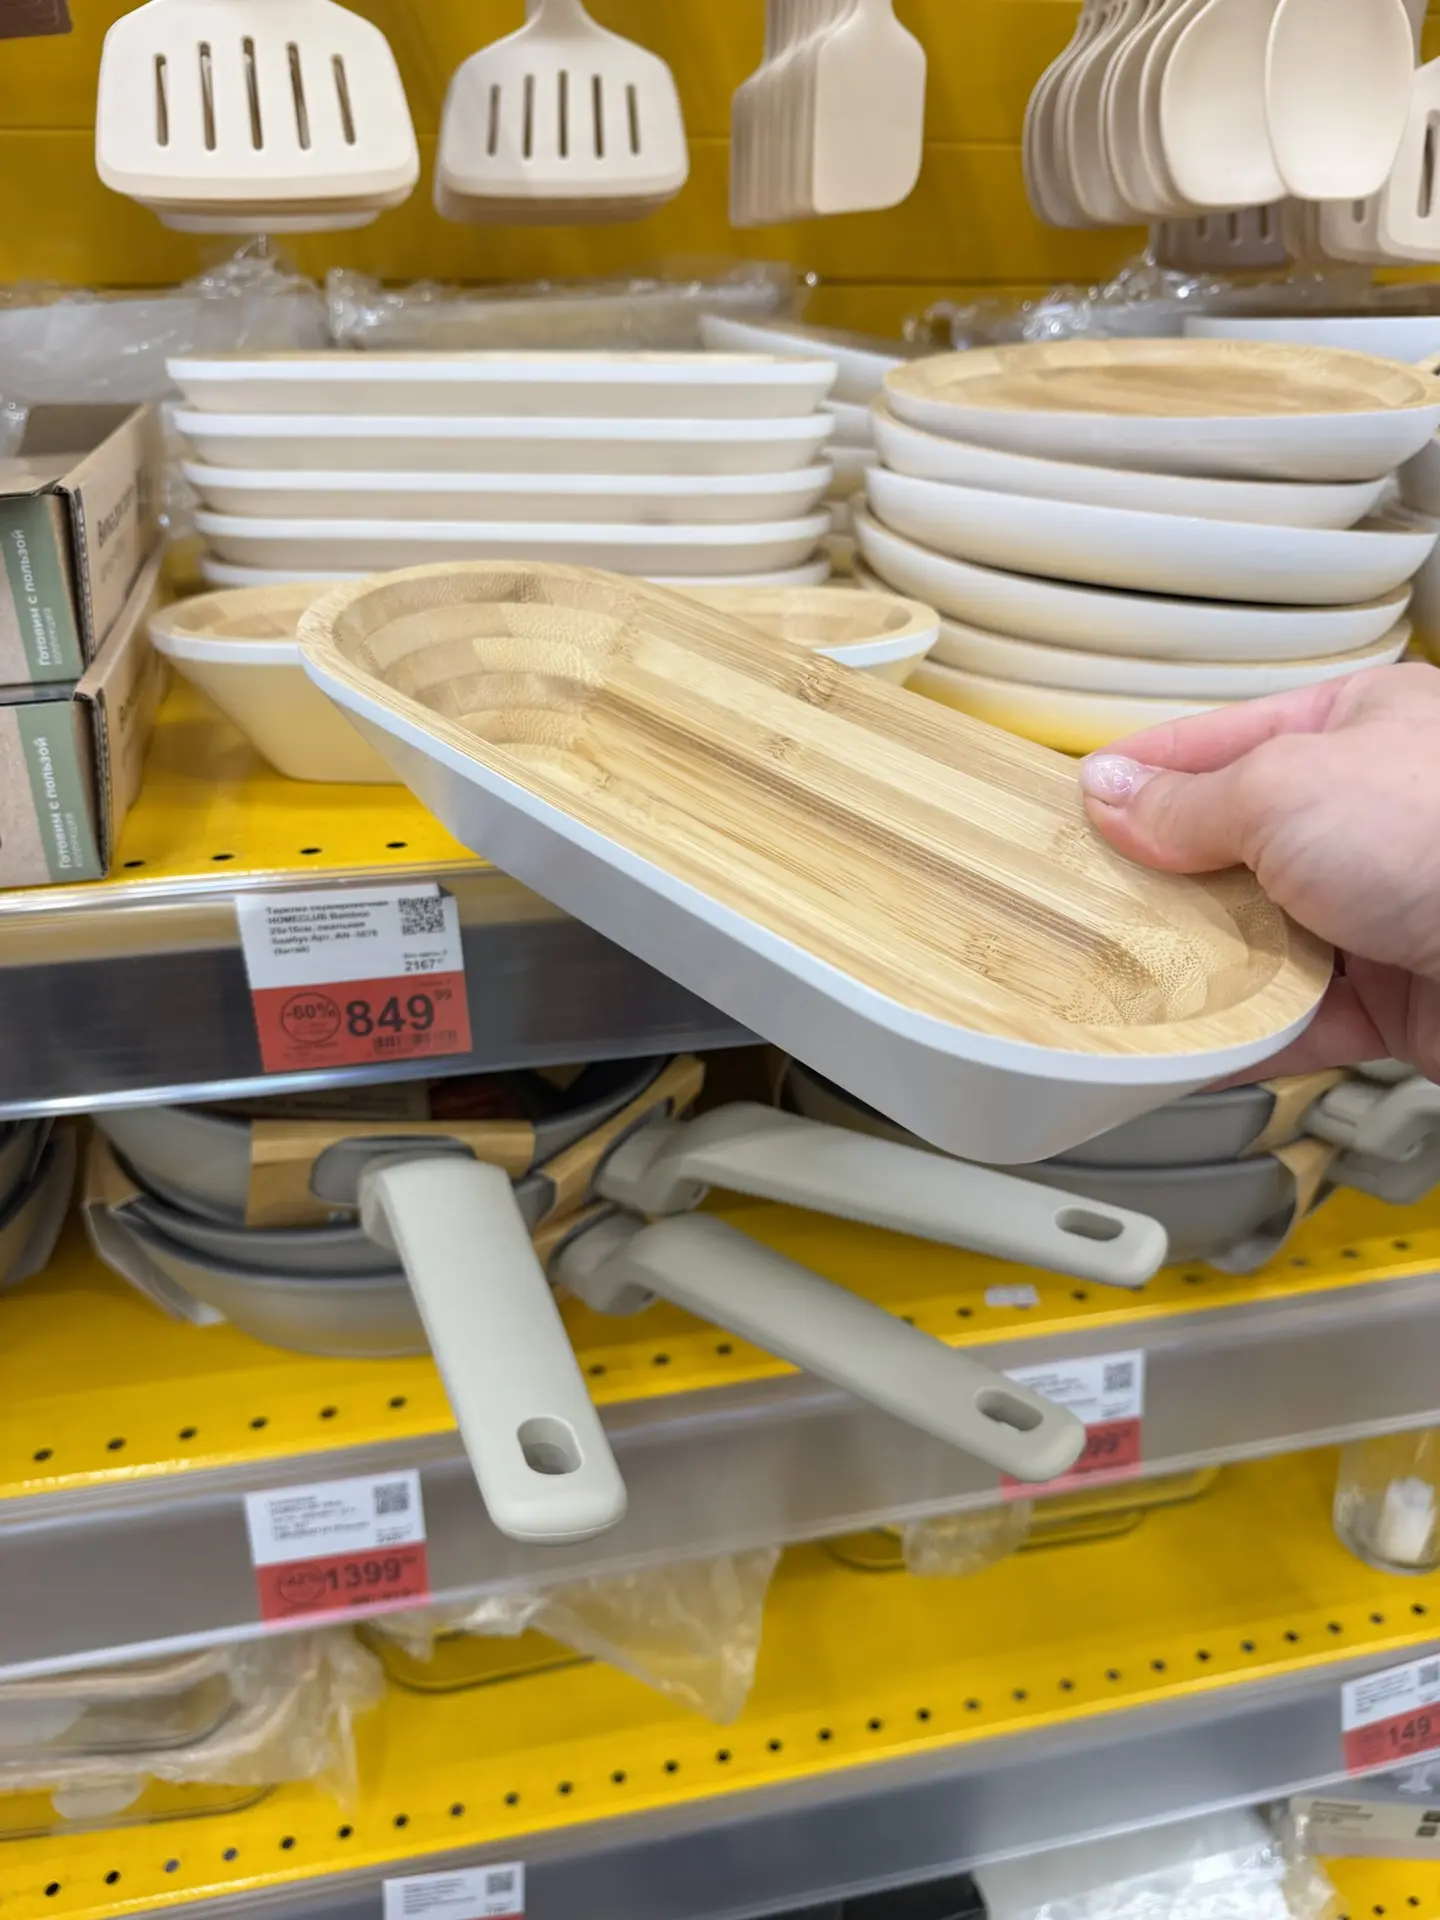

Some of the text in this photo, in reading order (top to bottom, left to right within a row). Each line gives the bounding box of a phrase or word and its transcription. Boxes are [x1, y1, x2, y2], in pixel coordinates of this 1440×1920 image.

[10, 529, 52, 666] Готовим с пользой
[32, 737, 73, 869] Готовим с пользой
[268, 913, 327, 924] HOMECLUB
[404, 958, 435, 972] 2167
[285, 1002, 337, 1020] -60%
[345, 993, 435, 1038] 849
[326, 1556, 402, 1590] 1399
[1387, 1715, 1431, 1746] 149
